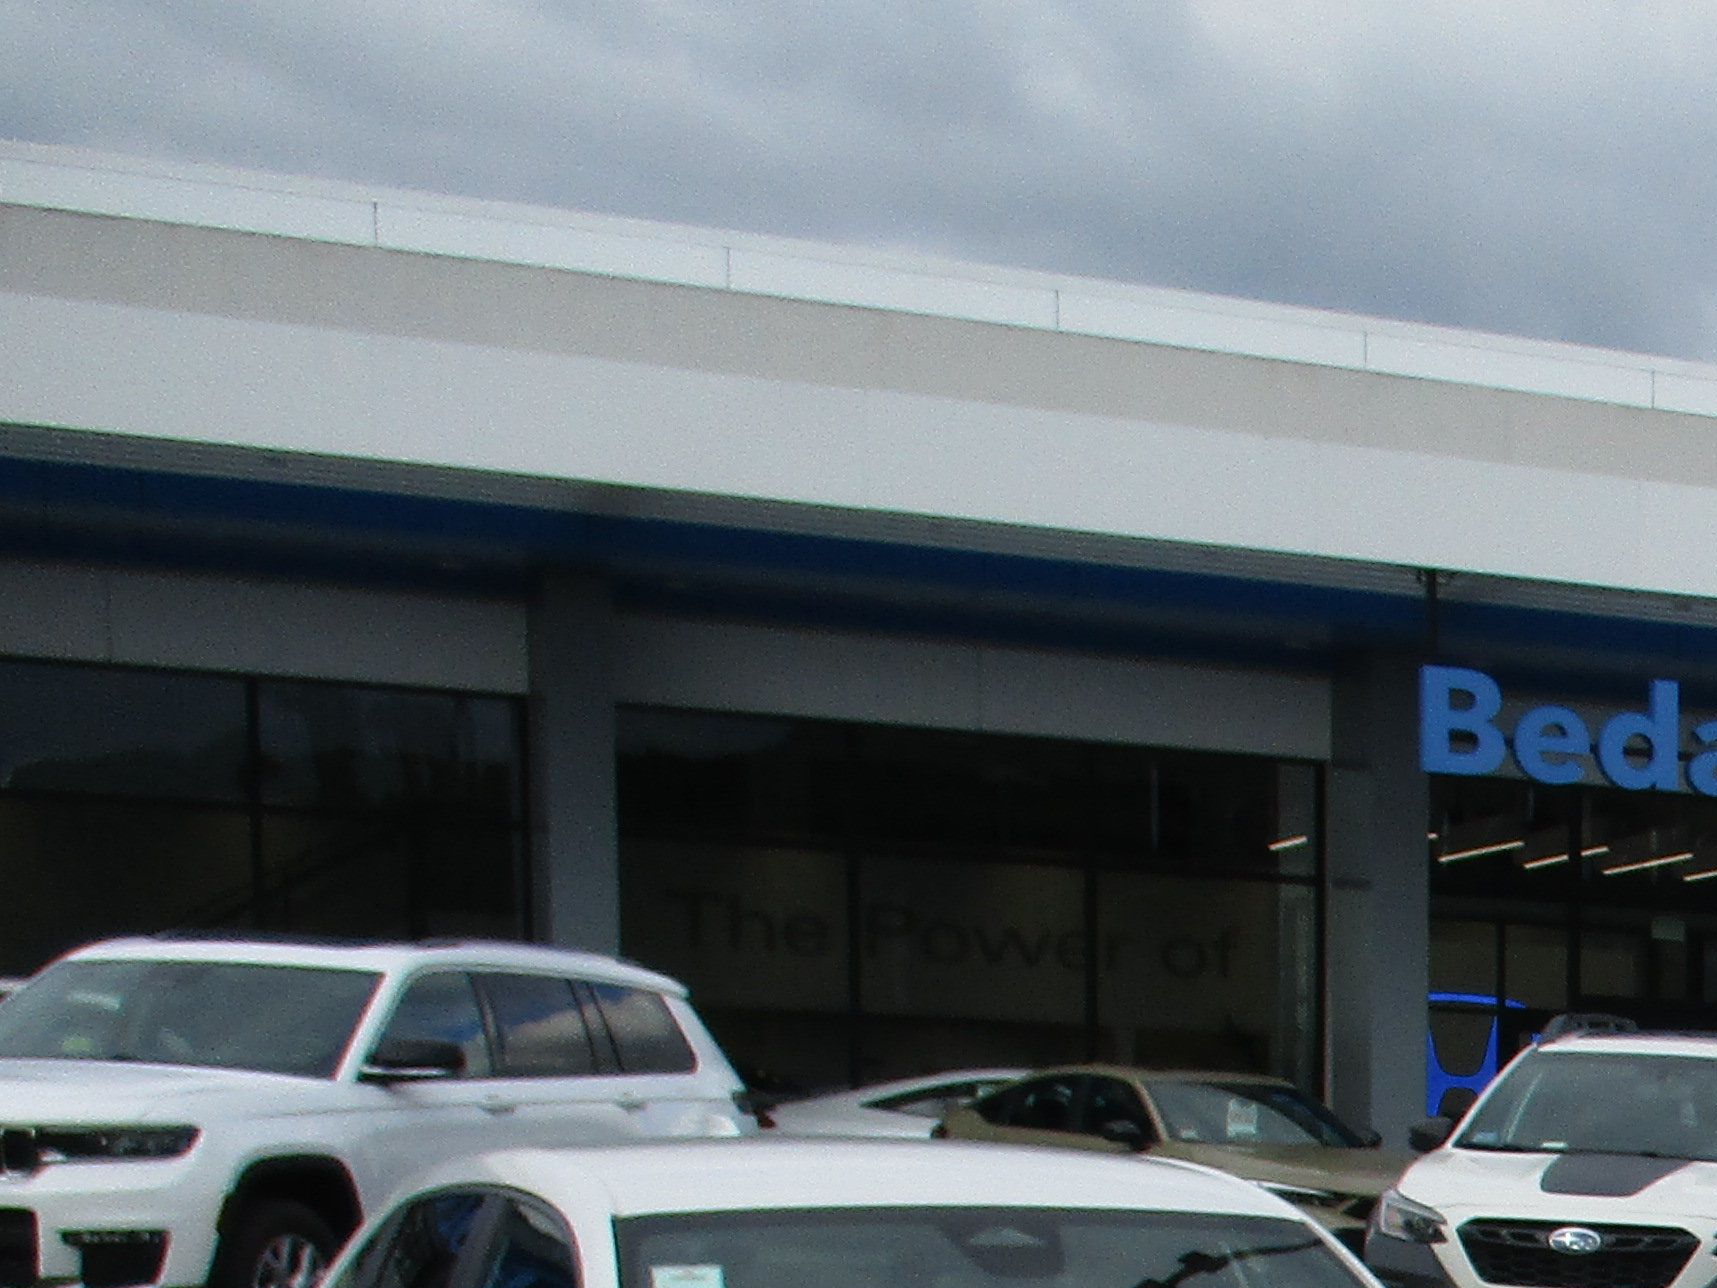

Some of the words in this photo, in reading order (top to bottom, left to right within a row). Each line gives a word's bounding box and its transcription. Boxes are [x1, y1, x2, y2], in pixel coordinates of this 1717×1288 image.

[666, 888, 828, 956] The
[864, 900, 1134, 971] Power
[1160, 927, 1239, 979] of
